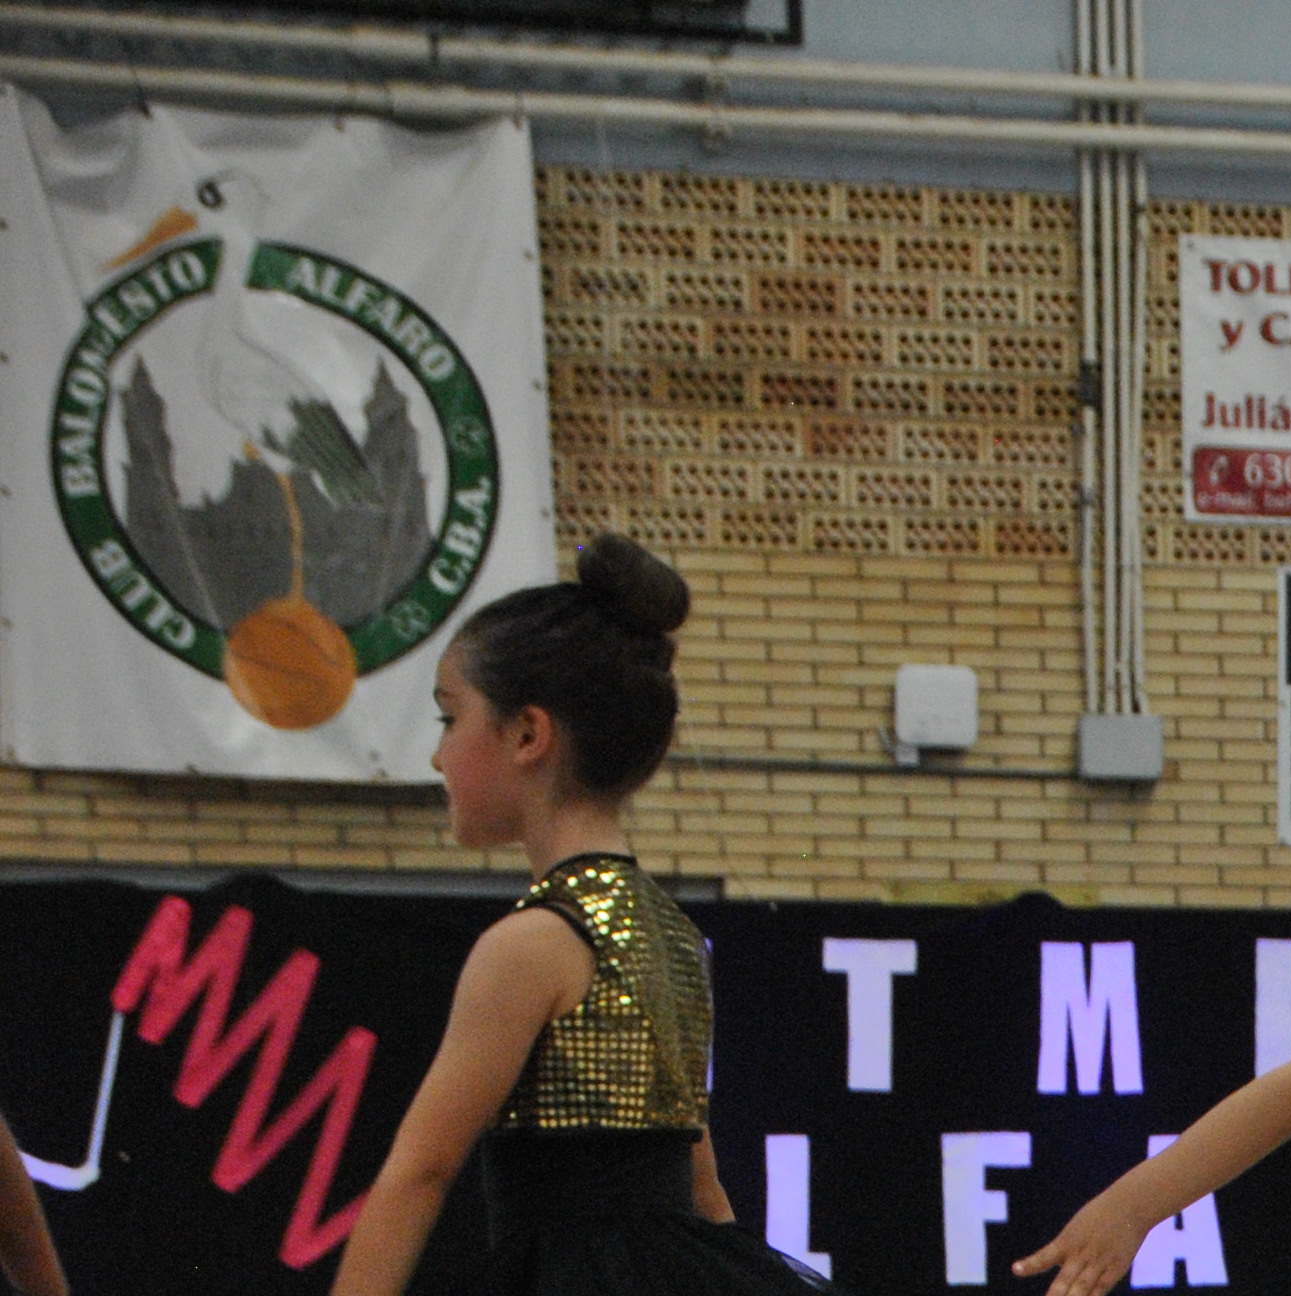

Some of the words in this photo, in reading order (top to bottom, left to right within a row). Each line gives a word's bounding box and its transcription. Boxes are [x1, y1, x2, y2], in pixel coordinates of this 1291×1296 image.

[286, 259, 457, 382] ALFARO
[1219, 319, 1245, 351] y
[428, 477, 492, 593] C.B.A.
[91, 543, 196, 649] CLUB
